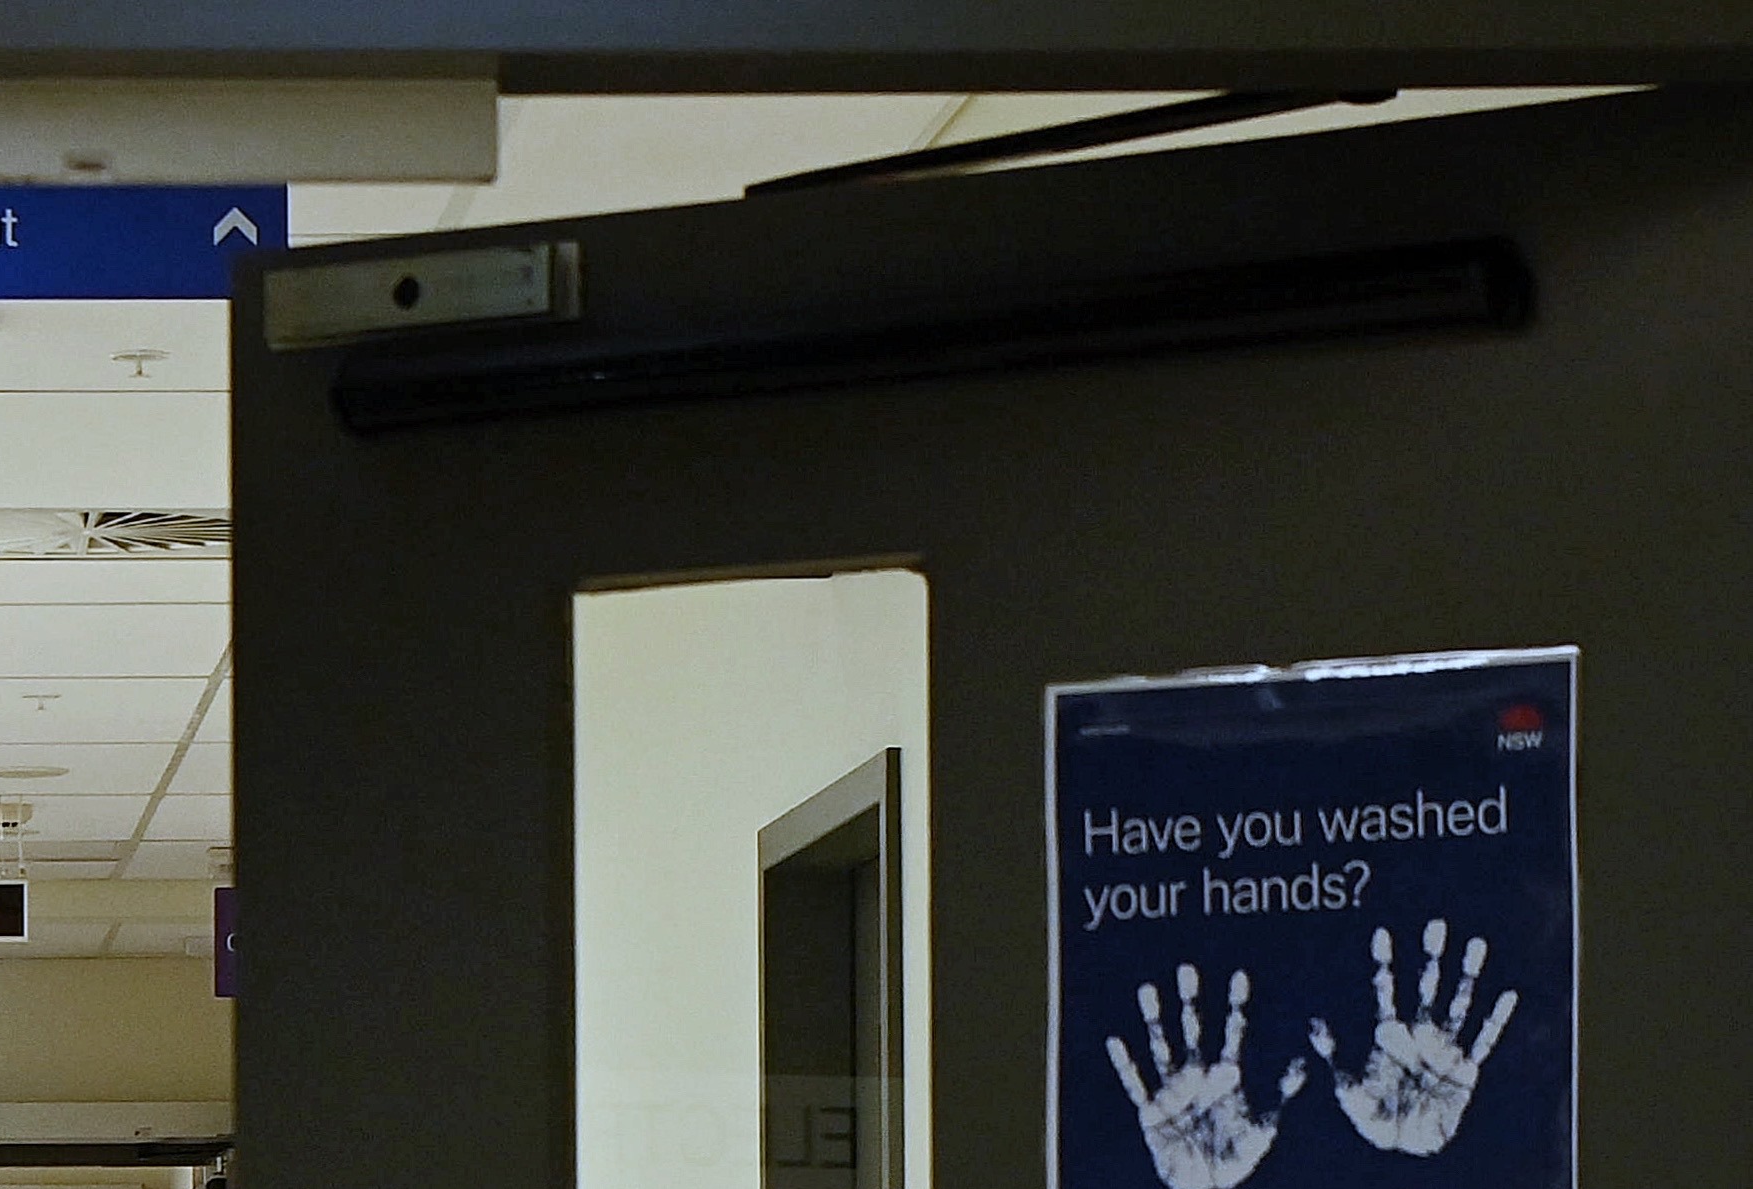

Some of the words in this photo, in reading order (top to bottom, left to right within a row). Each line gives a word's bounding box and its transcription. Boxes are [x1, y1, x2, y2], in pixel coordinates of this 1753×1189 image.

[1496, 731, 1544, 751] NSW
[1082, 806, 1203, 858] Have
[1215, 808, 1303, 860] you
[1317, 783, 1509, 844] washed
[1082, 880, 1186, 932] your
[1202, 859, 1372, 917] hands?
